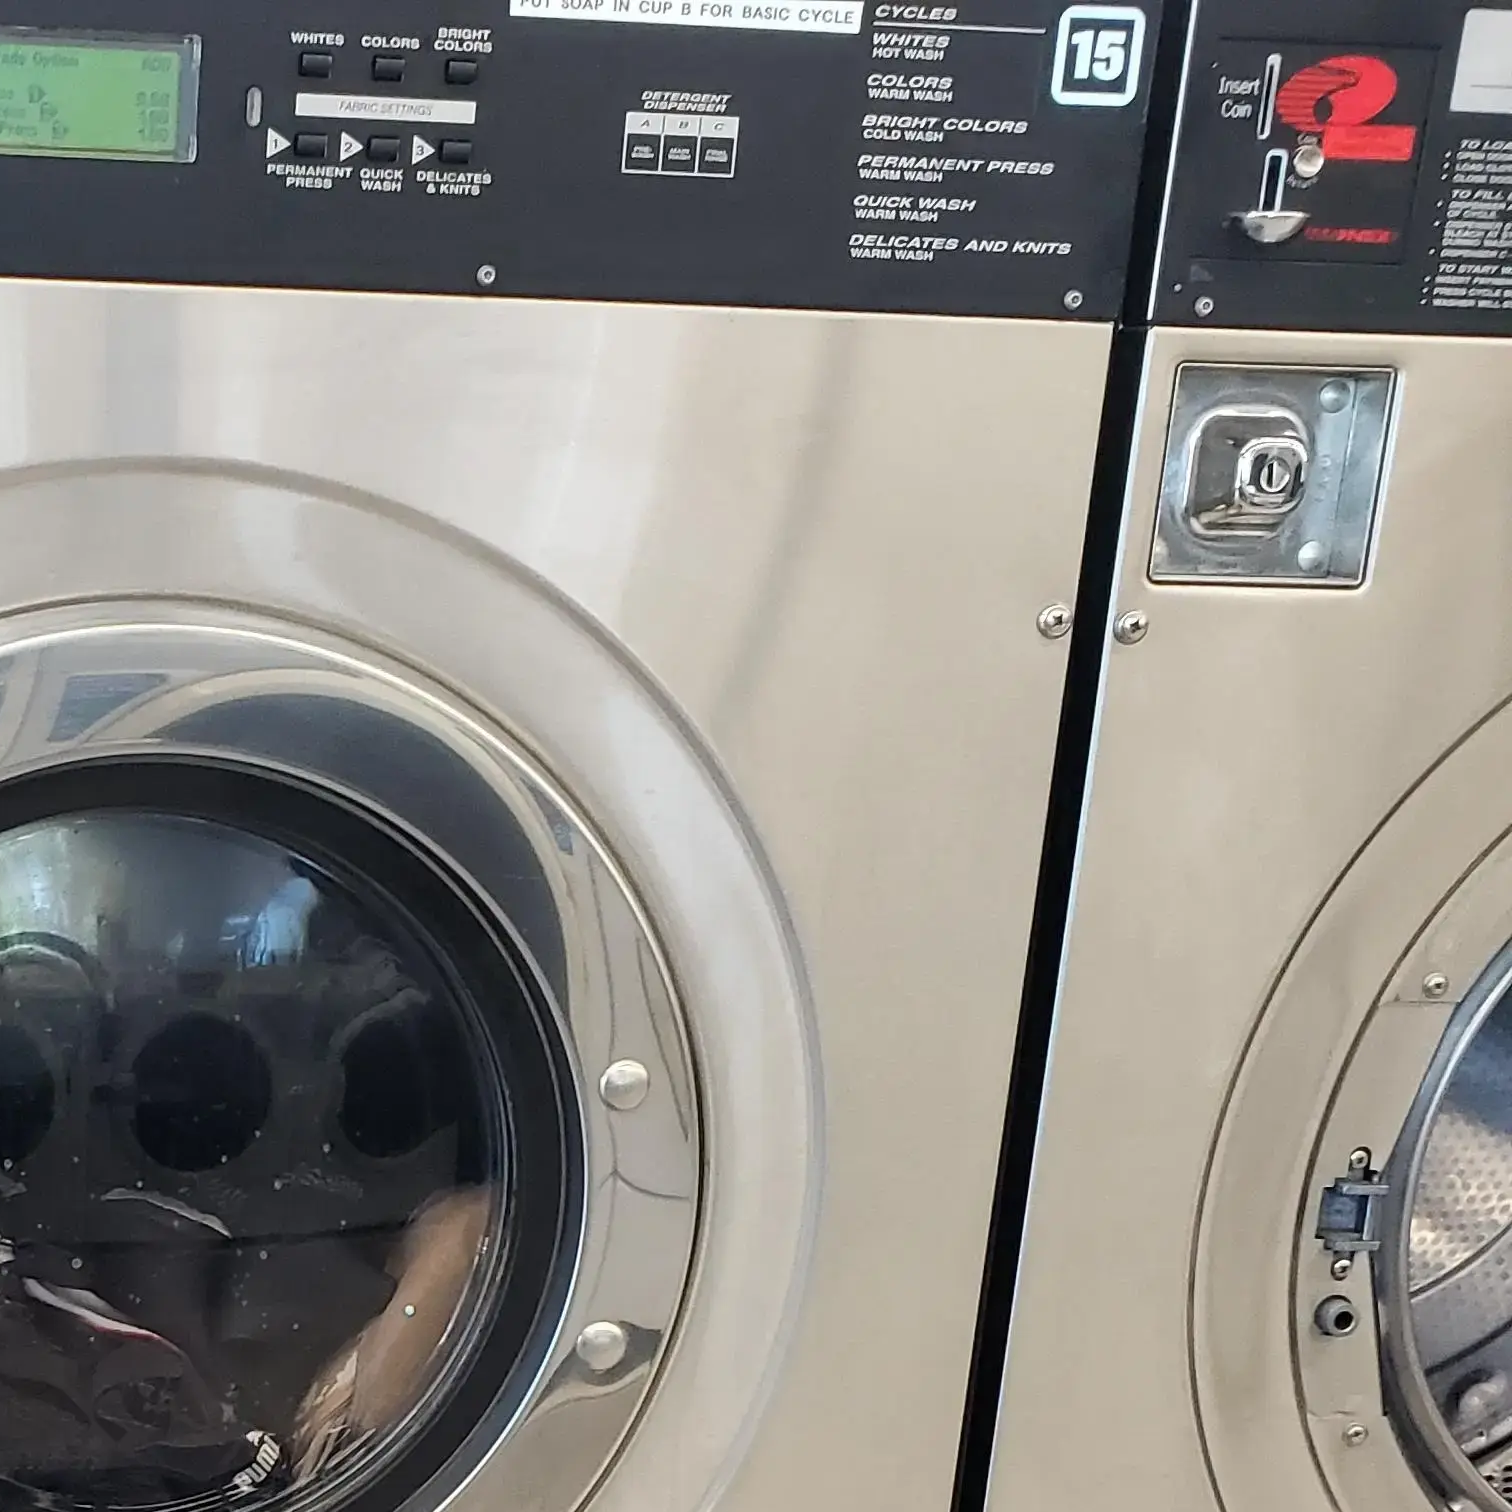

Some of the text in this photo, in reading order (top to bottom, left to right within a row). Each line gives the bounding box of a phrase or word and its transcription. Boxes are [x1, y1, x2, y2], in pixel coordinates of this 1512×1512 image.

[561, 0, 604, 12] SOAP
[614, 0, 630, 13] IN
[639, 1, 673, 15] CUP
[681, 3, 692, 16] B
[700, 4, 733, 18] FOR
[742, 5, 790, 21] BASIC
[798, 9, 855, 25] CYCLE
[874, 5, 958, 21] CYCLES
[291, 32, 345, 46] WHITES
[438, 27, 491, 41] BRIGHT
[872, 32, 951, 48] WHITES
[361, 36, 420, 50] COLORS
[434, 39, 493, 53] COLORS
[872, 47, 944, 61] HOT WASH
[1069, 29, 1128, 81] 15
[867, 73, 953, 90] COLORS
[1218, 75, 1261, 97] Insert
[641, 90, 733, 104] DETERGENT
[867, 88, 953, 103] WARM WASH
[338, 101, 434, 117] FABRIC SETTINGS
[643, 101, 728, 113] DISPENSER
[1221, 99, 1253, 119] Coin
[640, 120, 650, 128] A
[862, 114, 1028, 134] BRIGHT COLORS
[863, 128, 944, 142] COLD WASH
[344, 142, 353, 152] 2
[416, 145, 425, 156] 3
[266, 164, 353, 179] PERMANENT
[857, 154, 1055, 176] PERMANENT PRESS
[359, 168, 403, 182] QUICK
[416, 170, 492, 185] DELICATES
[858, 168, 943, 183] WARM WASH
[286, 176, 332, 190] PRESS
[361, 180, 402, 193] WASH
[426, 183, 480, 197] & KNITS
[853, 194, 977, 212] QUICK WASH
[855, 208, 939, 223] WARM WASH
[849, 233, 1072, 256] DELICATES AND KNITS
[850, 247, 934, 262] WARM WASH
